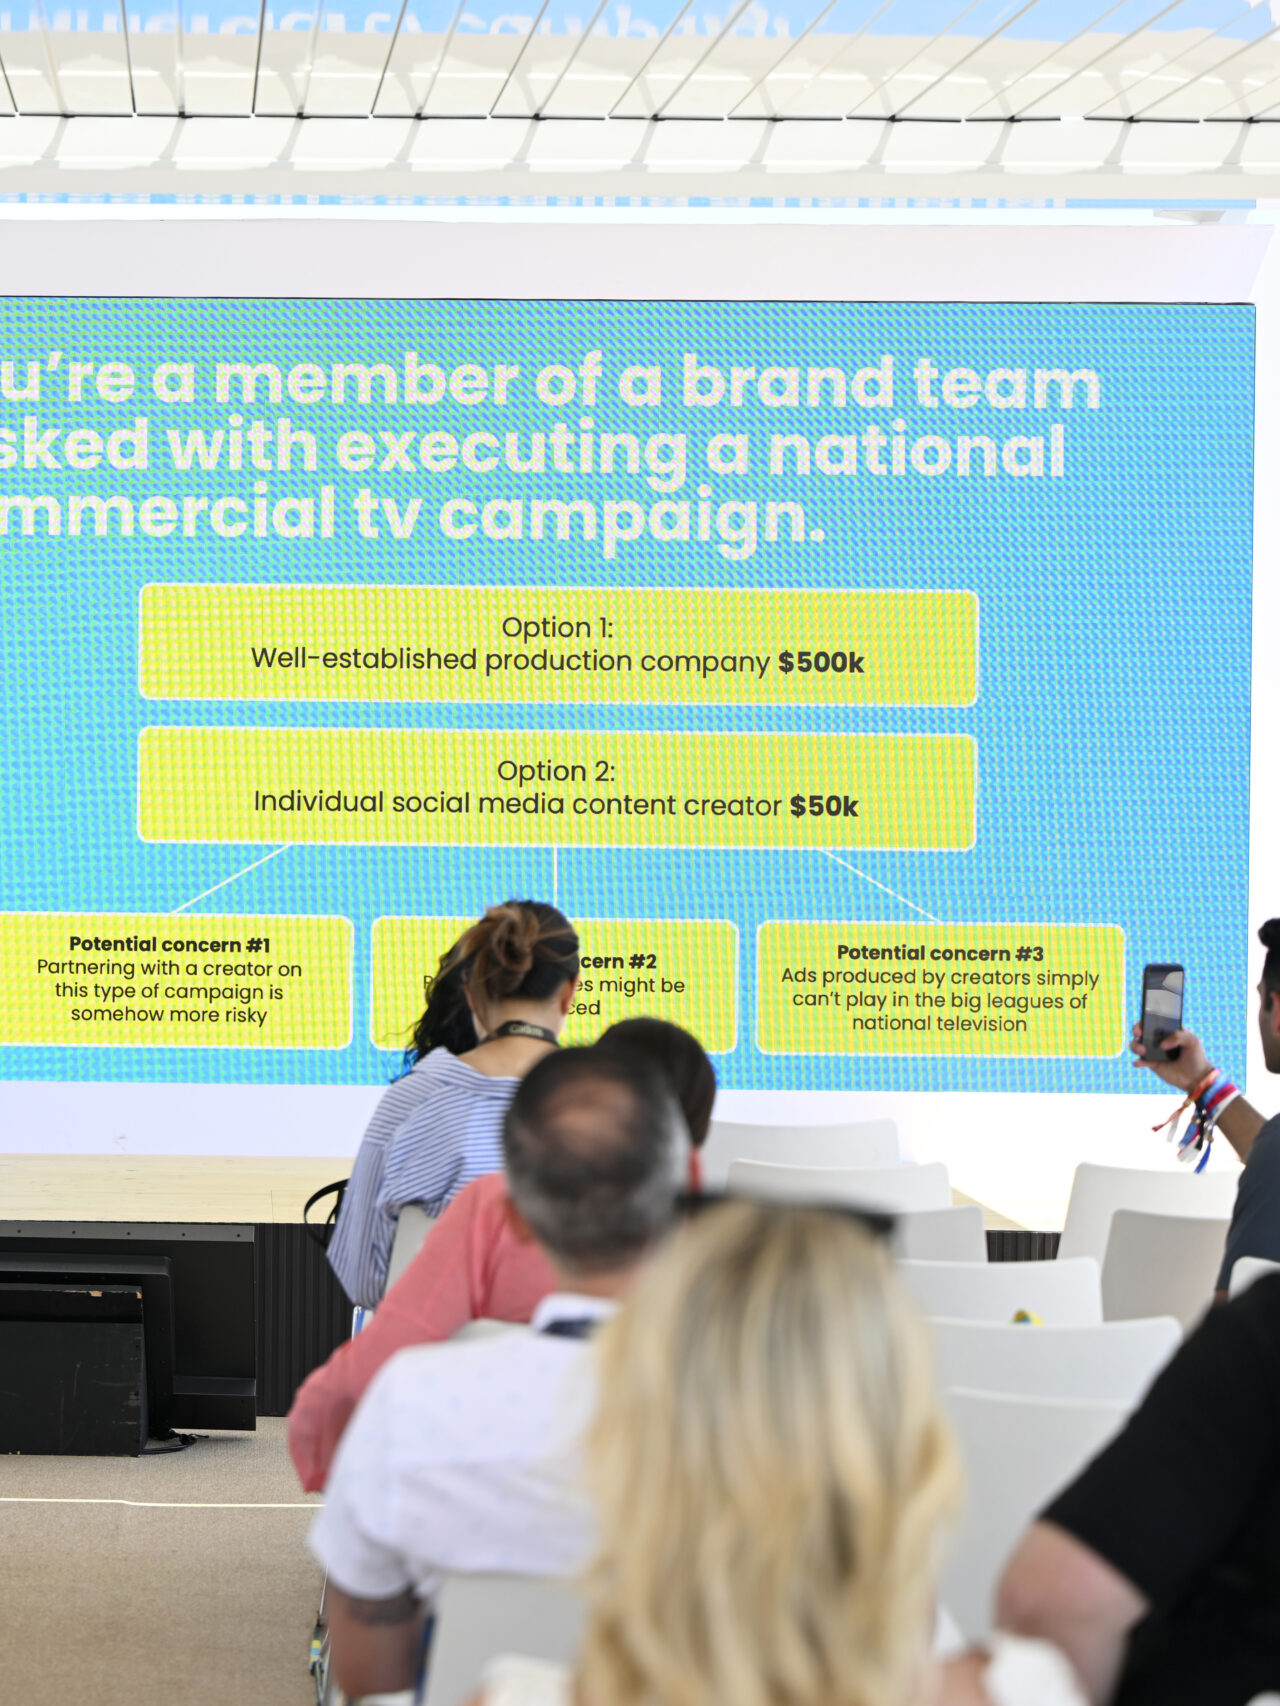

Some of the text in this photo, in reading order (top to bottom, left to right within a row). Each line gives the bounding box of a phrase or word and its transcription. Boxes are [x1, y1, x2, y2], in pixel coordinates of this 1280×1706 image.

[153, 361, 195, 403] a
[215, 352, 519, 405] member
[536, 349, 603, 405] of
[619, 364, 662, 406] a
[683, 353, 894, 407] brand
[913, 358, 1100, 409] team
[167, 413, 317, 471] with
[336, 416, 687, 493] executing
[707, 432, 749, 474] a
[770, 418, 1065, 476] national
[355, 488, 423, 538] tv
[439, 484, 825, 560] campaign.
[503, 616, 612, 643] Option 1:
[252, 647, 864, 678] Well-established production company $500k
[498, 760, 614, 786] Option 2:
[256, 790, 858, 817] Individual social media content creator $50k
[70, 935, 270, 953] Potential concern #1
[837, 943, 1044, 962] Potential concern #3
[37, 959, 302, 980] Partnering with a creator on
[628, 953, 657, 969] #2
[599, 977, 655, 998] might
[661, 977, 685, 993] be
[781, 967, 1100, 991] Ads produced by creators simply
[55, 982, 283, 1005] this type of campaign is
[792, 991, 1088, 1014] can't play in the big leagues of
[71, 1006, 267, 1028] somehow more risky
[853, 1015, 1027, 1032] national television
